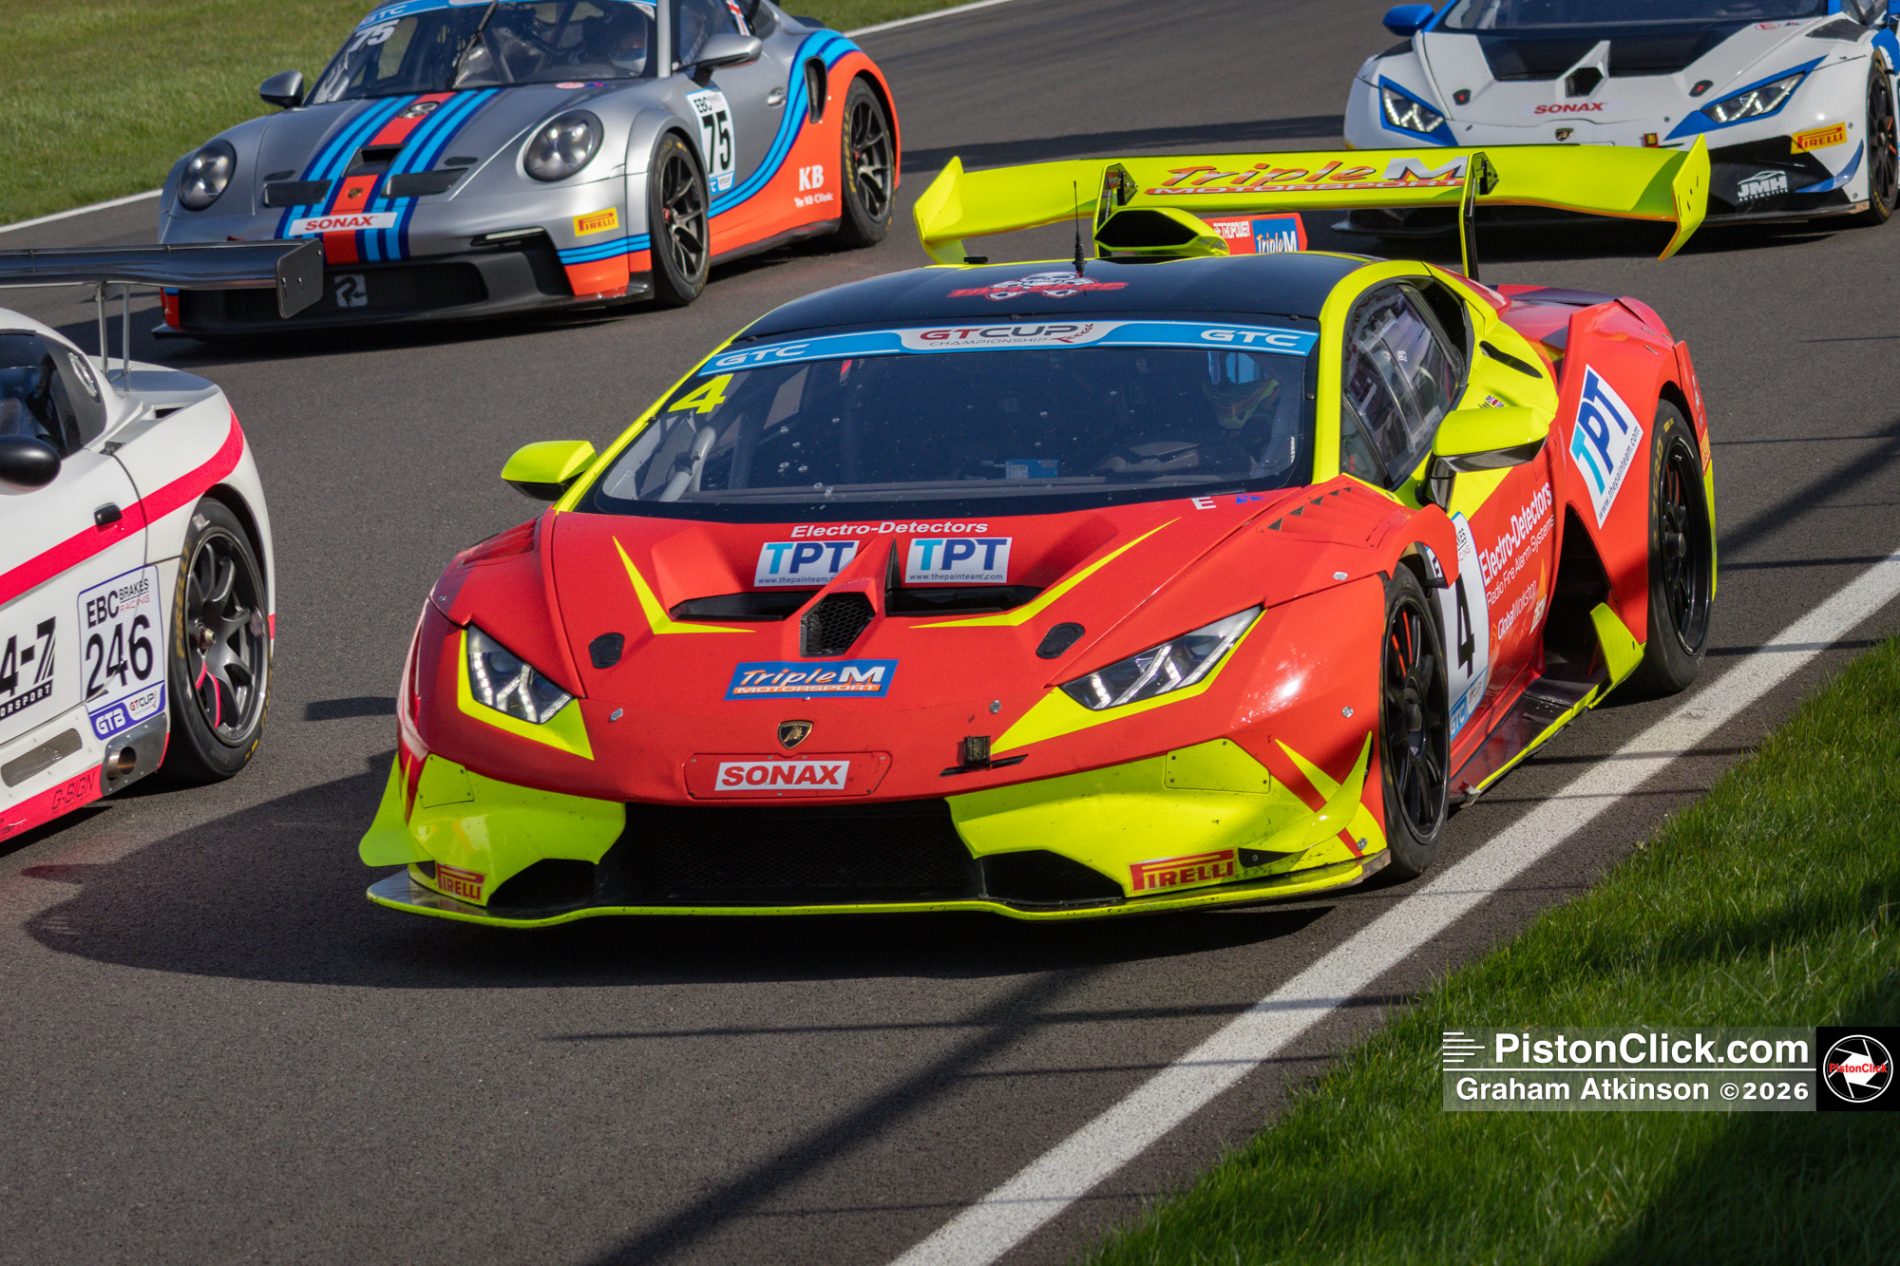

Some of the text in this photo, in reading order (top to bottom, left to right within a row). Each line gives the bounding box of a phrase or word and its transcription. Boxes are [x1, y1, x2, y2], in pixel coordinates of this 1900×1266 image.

[350, 19, 400, 52] 75
[693, 96, 713, 113] EBC
[1534, 102, 1604, 114] SONAX
[702, 110, 731, 174] 75
[1797, 127, 1843, 149] PIRELLI
[799, 165, 825, 191] KB
[1152, 179, 1464, 194] MOTORSPORT
[1738, 175, 1788, 198] JMH
[305, 217, 373, 231] SONAX
[578, 212, 616, 231] PIRELLI
[929, 337, 1050, 347] CHAMPIONSHIP
[1200, 329, 1300, 347] GTC
[716, 343, 810, 367] GTC
[668, 373, 734, 414] 4
[1571, 369, 1628, 497] TPT
[1191, 496, 1217, 510] E
[791, 521, 989, 538] Electro-Detectors
[1479, 481, 1553, 587] Electro-Detectors
[765, 541, 855, 574] TPT
[914, 538, 1007, 571] TPT
[119, 579, 149, 600] BRAKES
[86, 590, 119, 629] EBC
[1454, 573, 1475, 679] 4
[85, 614, 154, 700] 246
[736, 684, 877, 694] MOTORSPORT
[95, 707, 127, 736] GTB
[722, 765, 842, 787] SONAX
[437, 864, 485, 900] PIRELLI
[1130, 849, 1235, 891] PIRELLI
